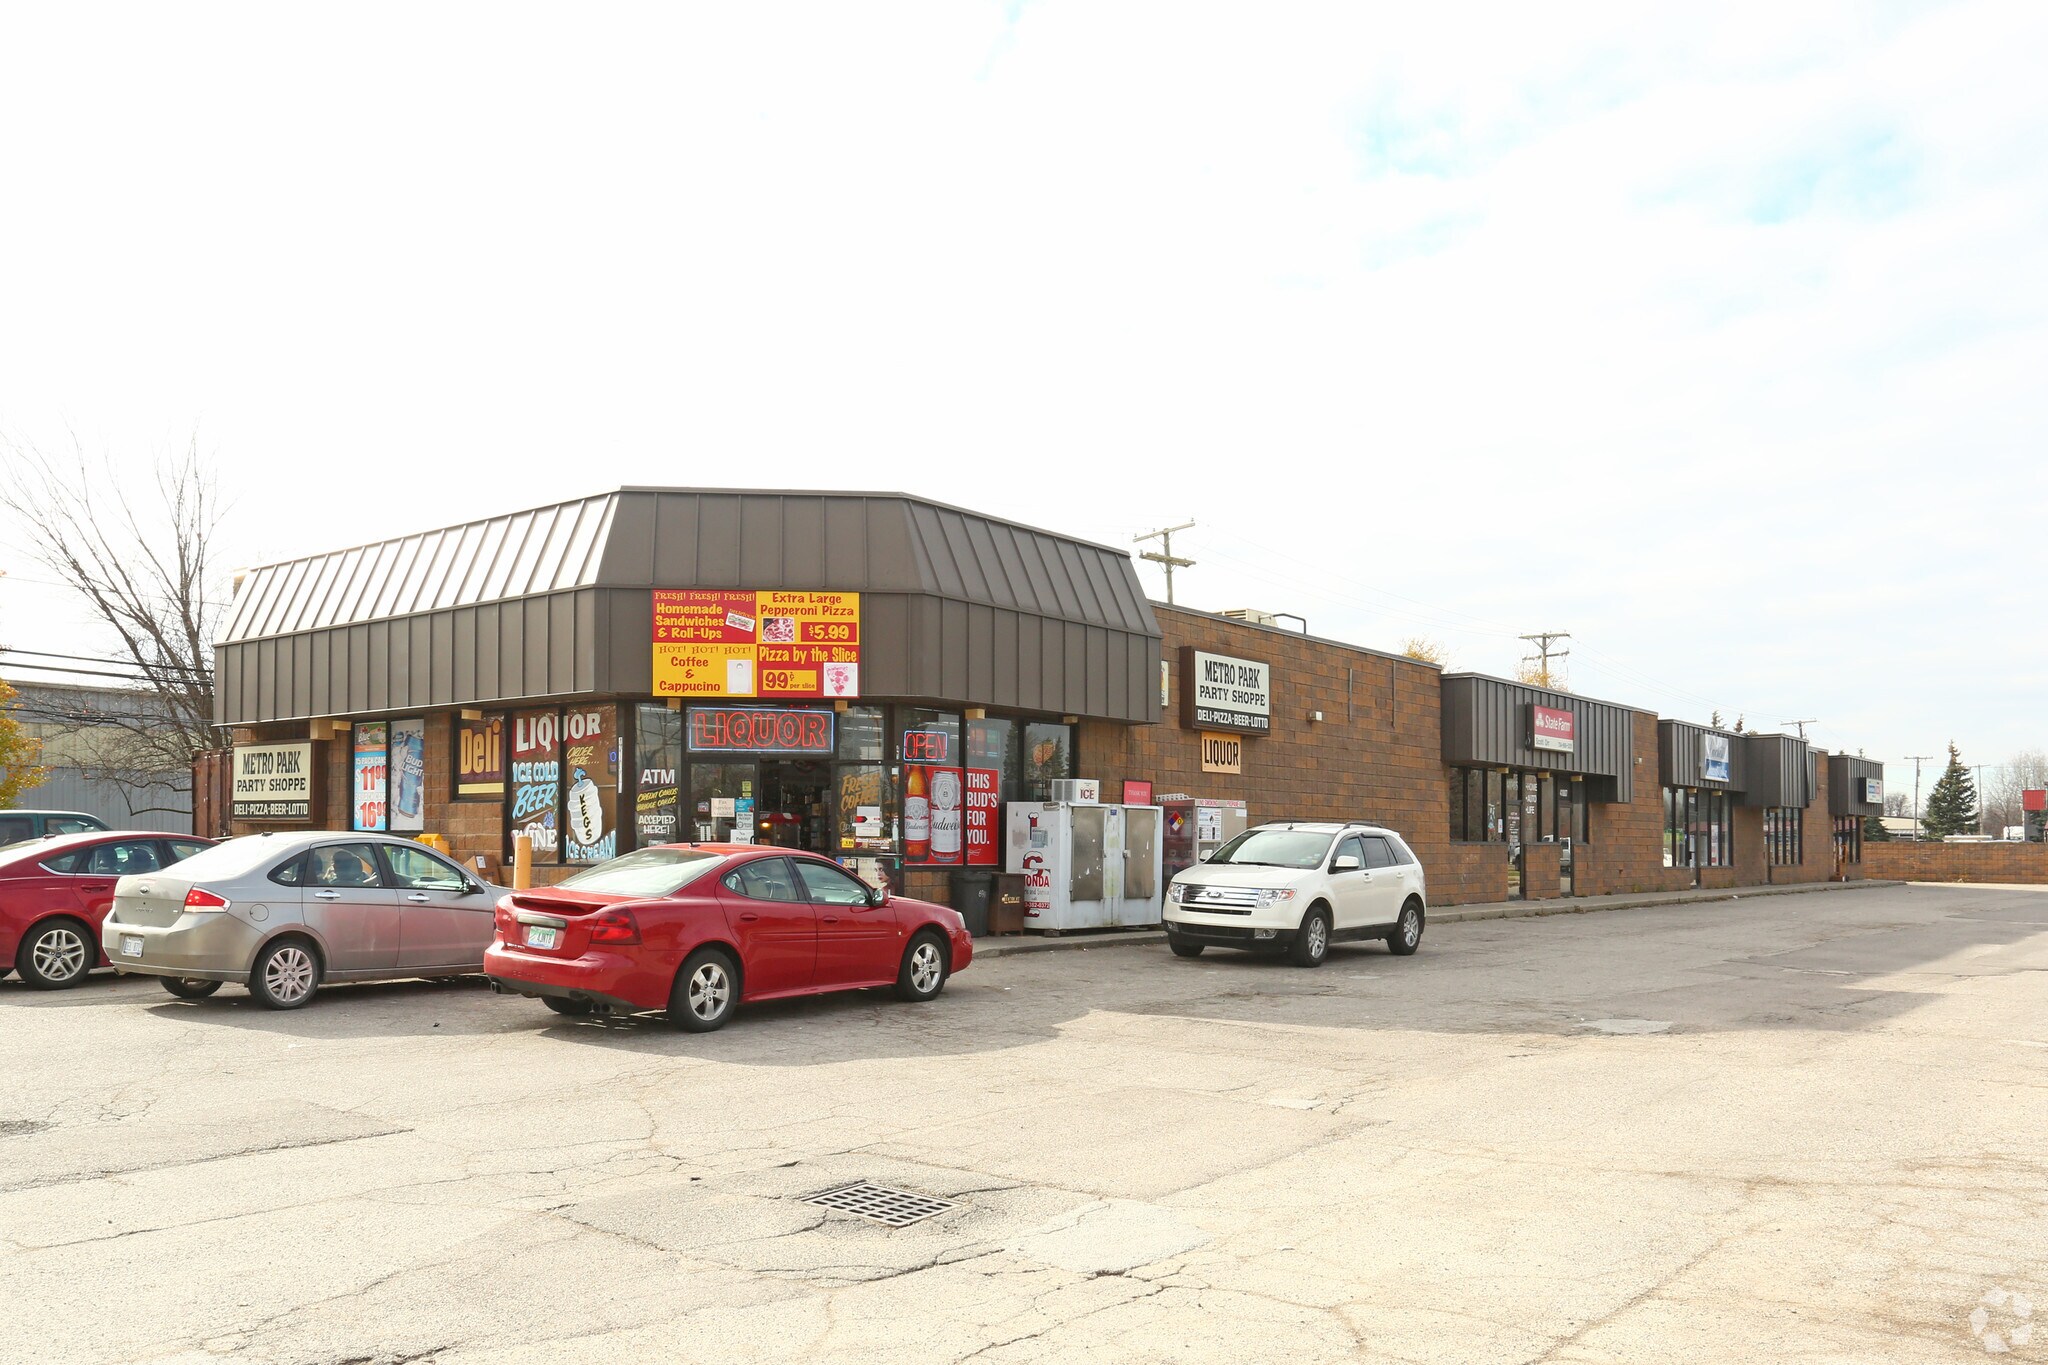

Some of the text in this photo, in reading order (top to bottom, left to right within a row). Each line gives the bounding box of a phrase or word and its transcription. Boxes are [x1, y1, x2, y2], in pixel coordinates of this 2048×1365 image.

[655, 592, 755, 602] FRESH! FRESH! FRESH!
[772, 592, 842, 605] Extra Large
[656, 603, 723, 615] Homemade
[760, 605, 854, 617] Pepperoni Pizza
[655, 615, 724, 627] Sandwiches
[657, 627, 722, 639] & Roll-Ups
[808, 624, 849, 640] $5.99
[659, 645, 751, 655] HOT! HOT! HOT!
[759, 646, 857, 664] Pizza by the Slice
[671, 656, 709, 667] Coffee
[685, 669, 695, 679] &
[1204, 659, 1260, 689] METRO PARK
[659, 680, 721, 693] Cappucino
[1199, 685, 1266, 706] PARTY SHOPPE
[695, 711, 827, 748] LIQUOR
[1545, 714, 1571, 732] State Farm
[516, 712, 601, 753] LIQUOR
[460, 719, 501, 775] Deli
[567, 745, 594, 759] ORDER
[905, 733, 945, 759] OPEN
[1204, 738, 1239, 767] LIQUOR
[242, 750, 301, 775] METRO PARK
[402, 761, 423, 777] LIGHT
[405, 754, 423, 768] BUD
[512, 760, 559, 783] ICE COLD
[641, 769, 675, 784] ATM
[236, 777, 306, 793] PARTY SHOPPE
[967, 772, 990, 789] THIS
[512, 783, 557, 820] BEER
[967, 791, 998, 808] BUD'S
[1080, 788, 1095, 799] ICE
[579, 794, 593, 841] KEGS
[638, 815, 676, 824] ACCEPTED
[967, 810, 987, 826] FOR
[512, 822, 557, 849] WINE
[643, 825, 670, 834] HERE!
[967, 829, 990, 845] YOU.
[566, 829, 616, 860] ICE CREAM
[1024, 875, 1049, 887] ONDA
